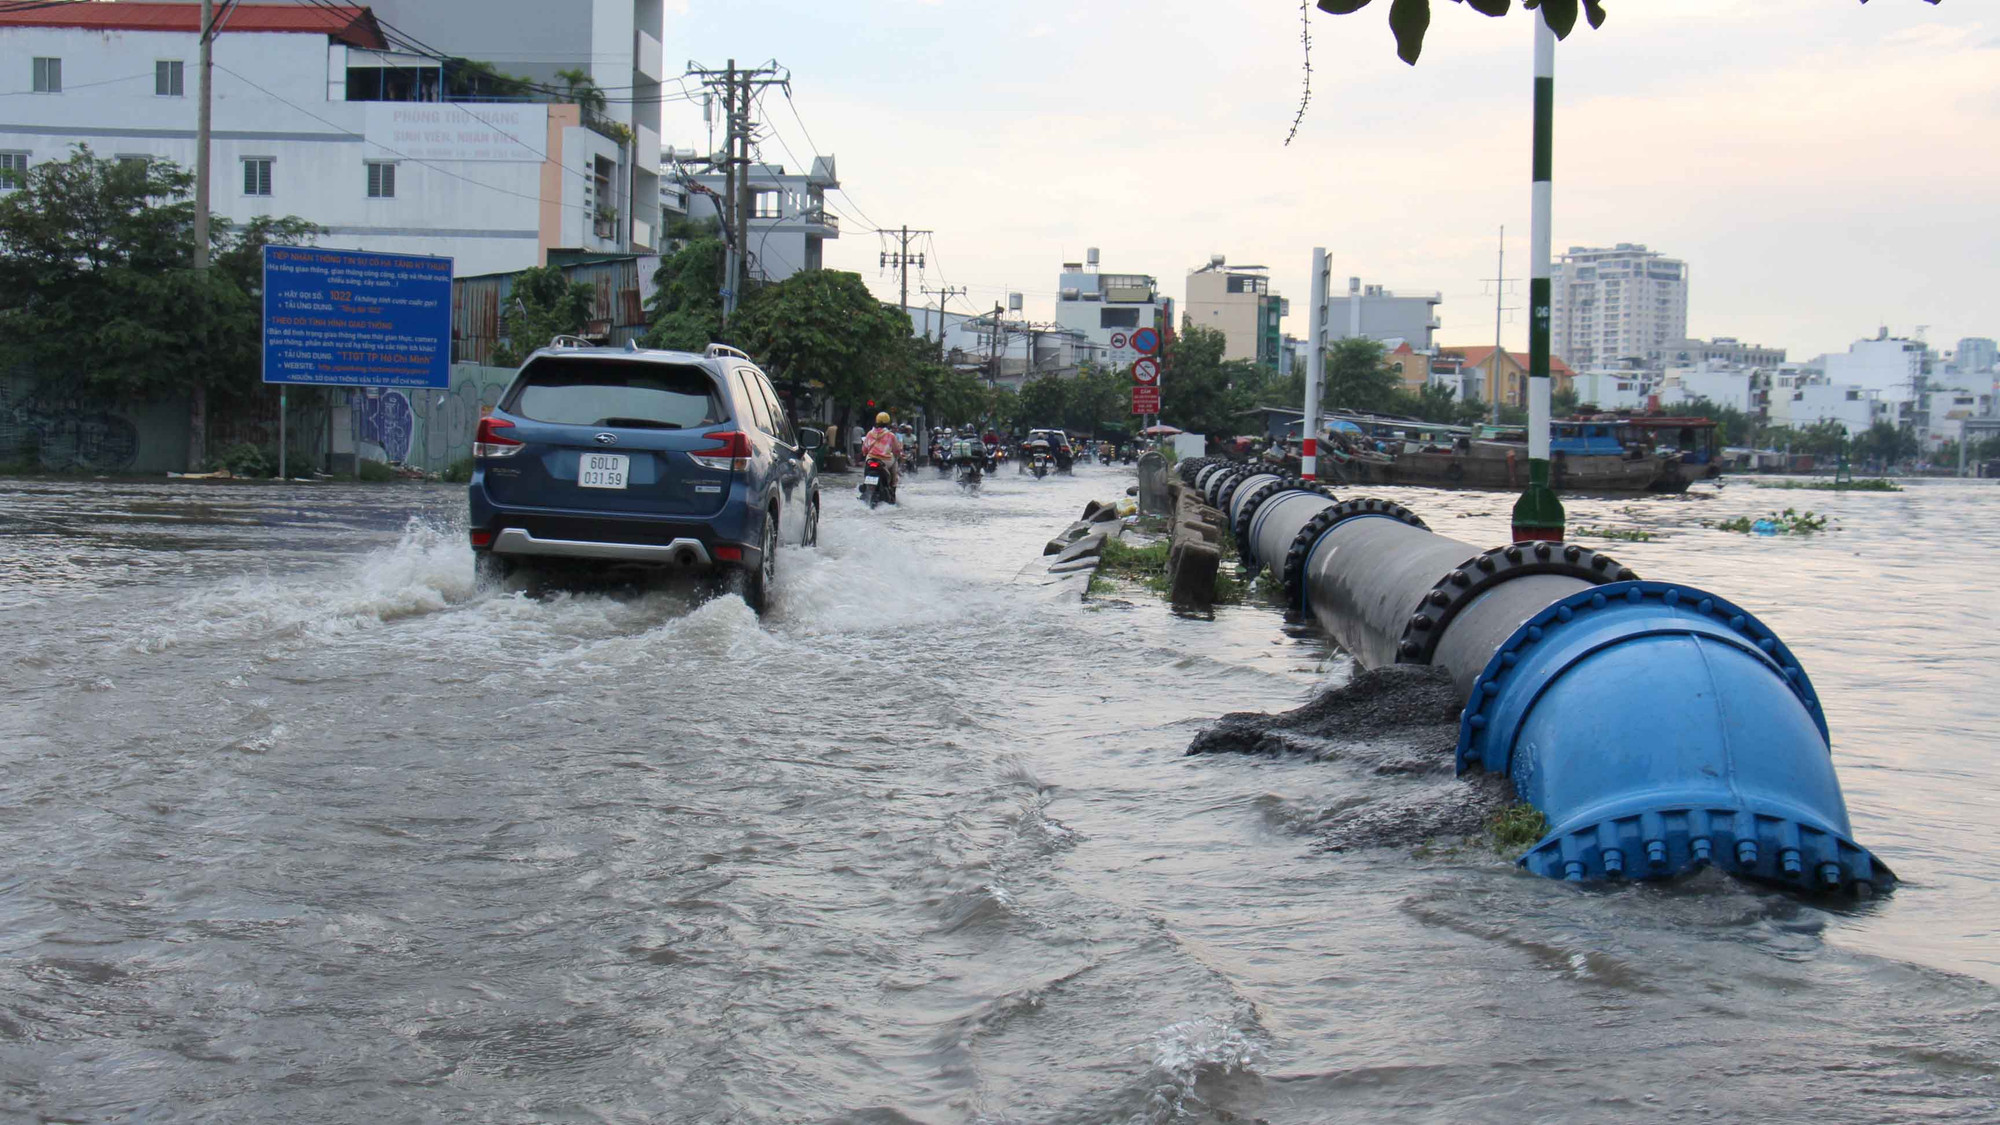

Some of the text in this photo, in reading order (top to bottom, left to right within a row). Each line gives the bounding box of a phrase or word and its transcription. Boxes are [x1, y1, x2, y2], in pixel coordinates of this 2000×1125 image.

[330, 290, 352, 301] 1022
[590, 456, 619, 471] 60LD
[584, 471, 622, 486] 031.59
